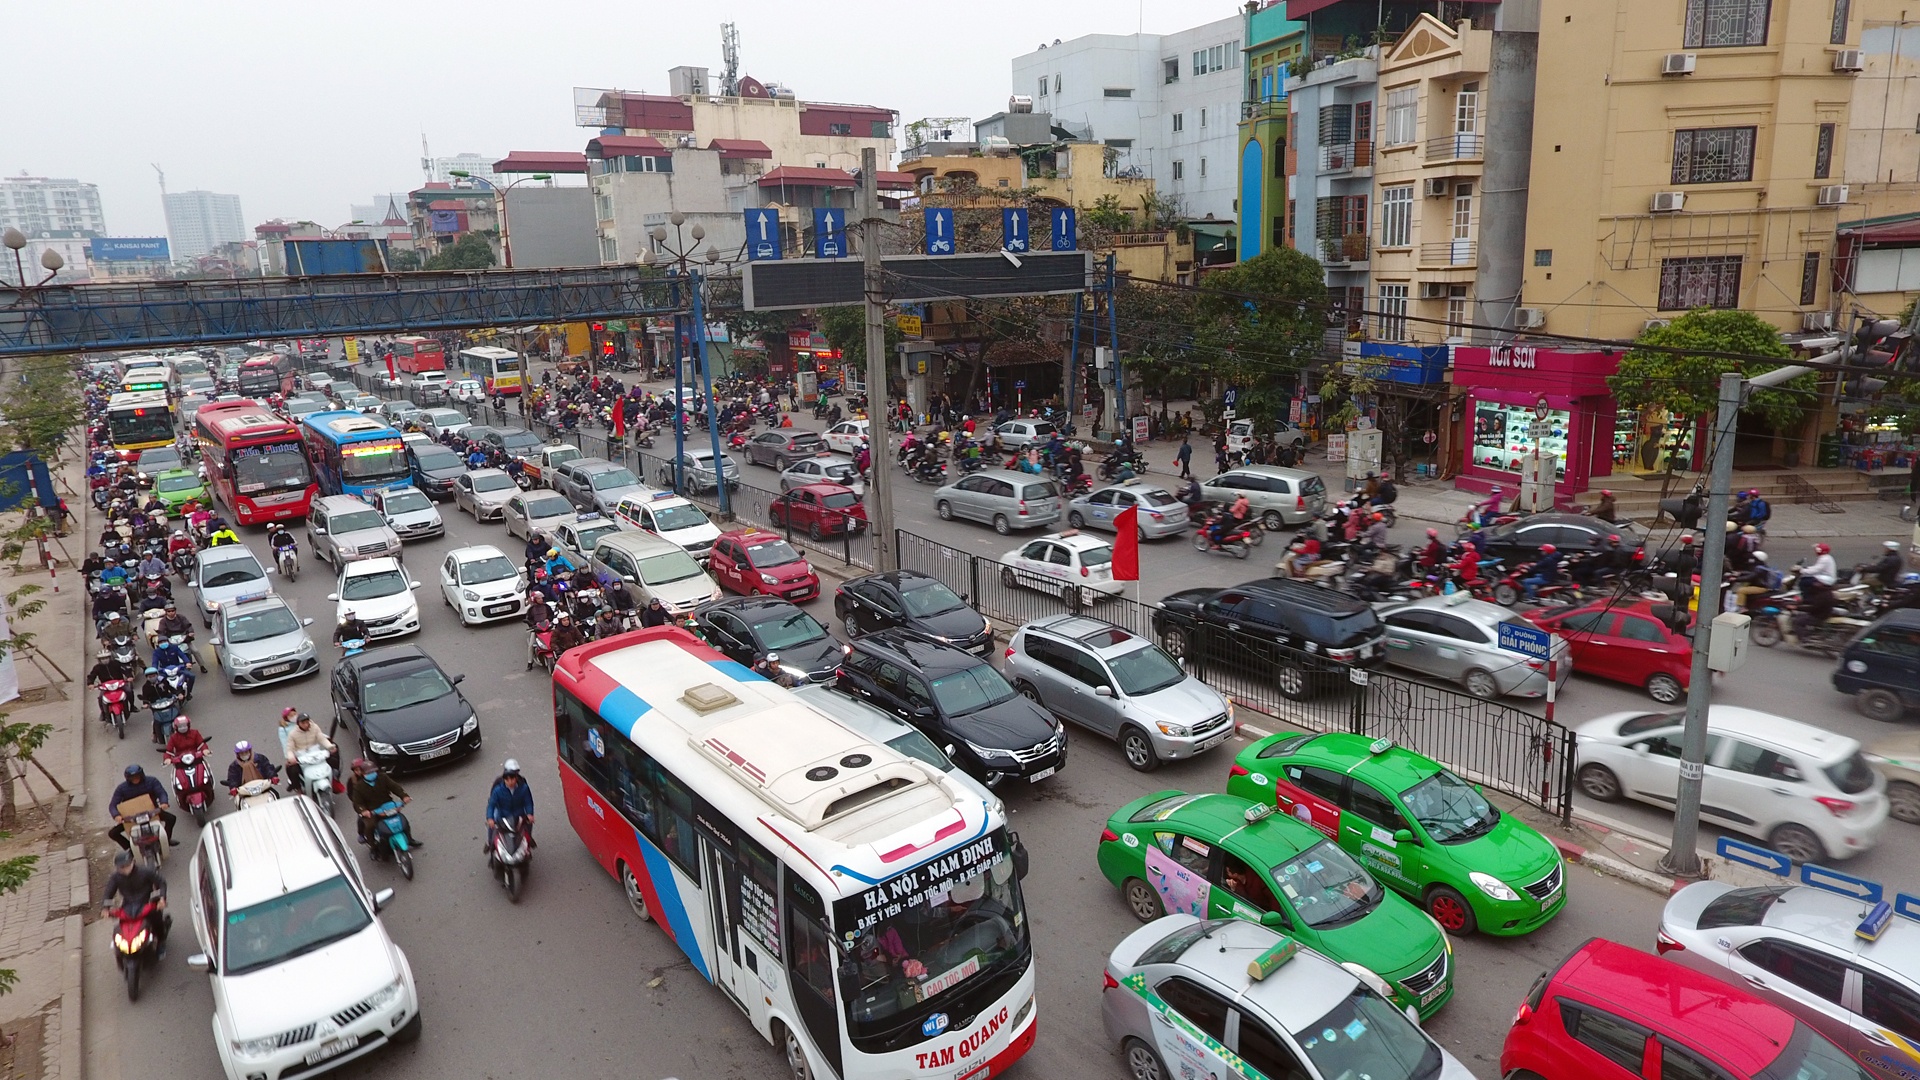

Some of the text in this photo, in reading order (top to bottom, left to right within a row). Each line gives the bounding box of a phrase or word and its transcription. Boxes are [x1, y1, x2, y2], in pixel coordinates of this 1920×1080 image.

[1489, 341, 1536, 369] NÓN SƠN
[1224, 390, 1236, 403] 20
[1501, 634, 1547, 656] GIẢI PHÓNG
[1514, 630, 1537, 641] ĐƯỜNG
[1250, 804, 1268, 818] TAXI
[864, 884, 889, 911] HÀ
[890, 872, 919, 900] NỘI
[928, 855, 960, 882] NAM
[961, 836, 994, 864] ĐỊNH
[857, 918, 865, 930] B
[866, 914, 877, 927] XE
[878, 908, 884, 921] Ý
[884, 901, 901, 918] YÊN
[907, 892, 923, 908] CAO
[924, 884, 939, 901] TỐC
[940, 877, 954, 893] MỚI
[960, 872, 966, 882] B
[966, 867, 976, 878] XE
[976, 860, 992, 874] GIÁP
[991, 852, 1004, 866] BÁT
[927, 982, 943, 997] CAO
[944, 972, 960, 989] TỐC
[916, 1006, 1009, 1069] TAM QUANG
[953, 1056, 986, 1080] ISUZU
